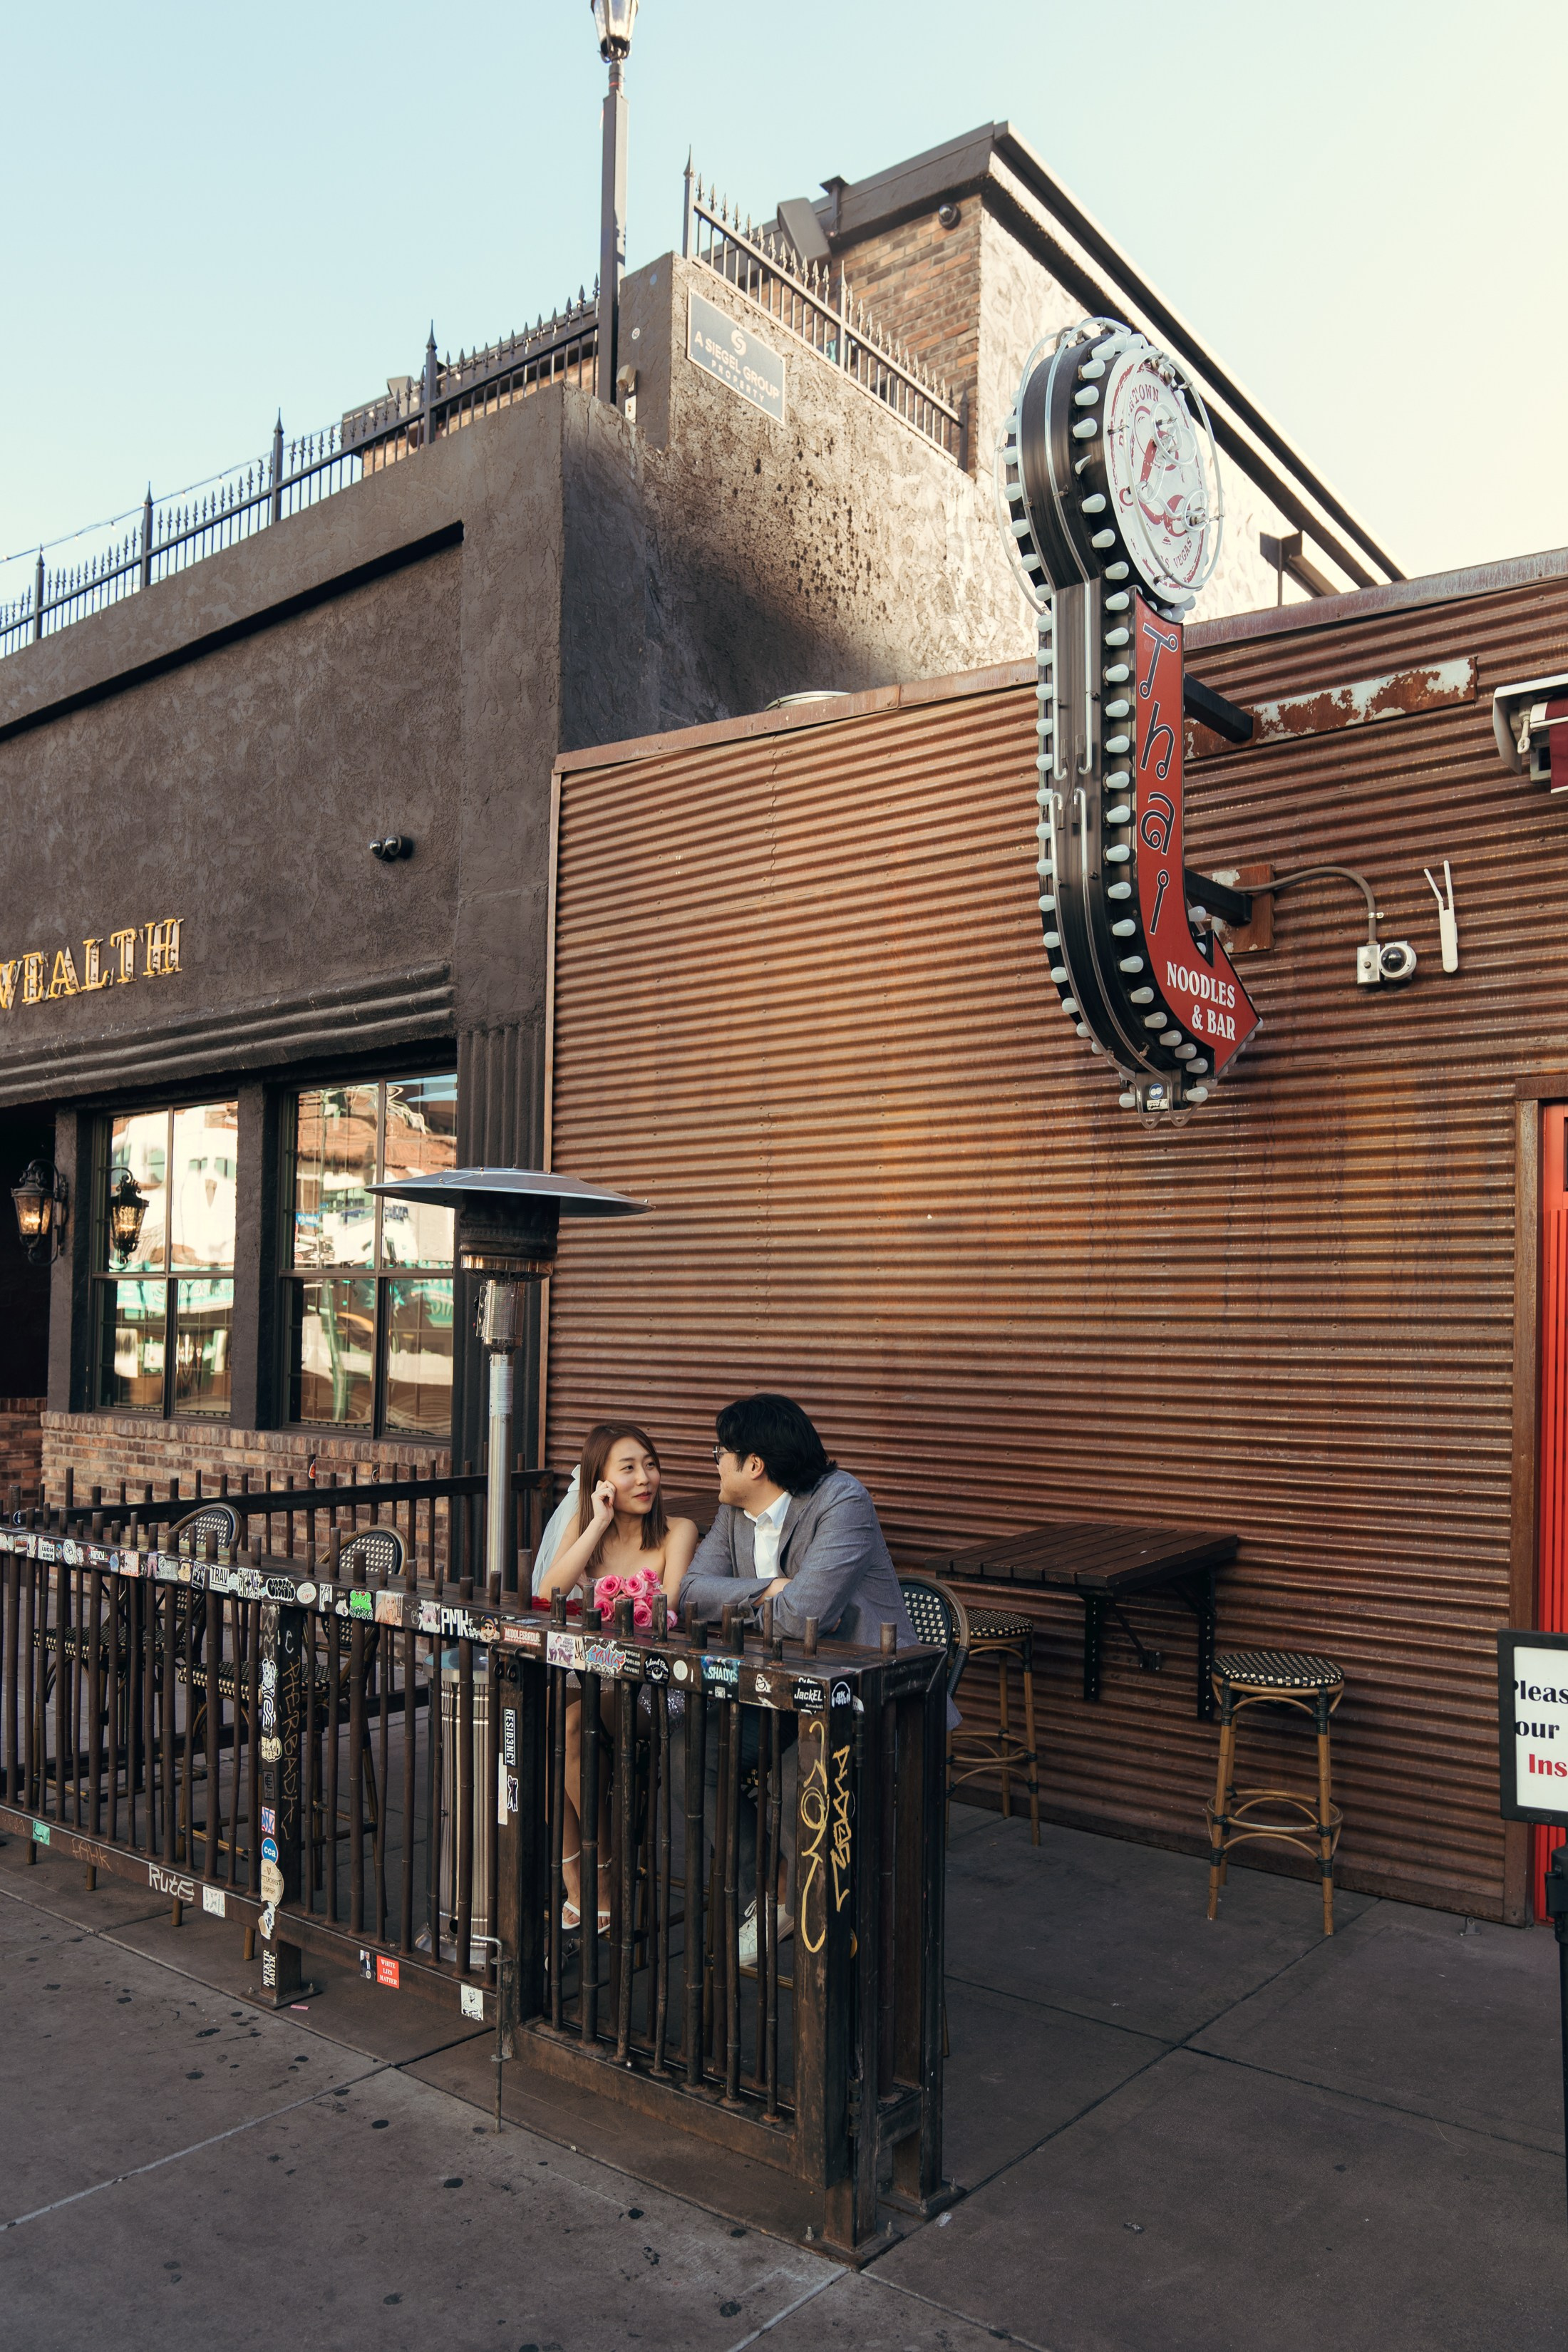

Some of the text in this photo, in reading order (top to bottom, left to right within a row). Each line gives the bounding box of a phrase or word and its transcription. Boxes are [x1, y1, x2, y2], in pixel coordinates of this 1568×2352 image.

[694, 331, 781, 400] A SIEGEL GROUP
[711, 359, 765, 403] PROPERTY
[1173, 537, 1192, 569] VEGAS
[1138, 622, 1179, 936] Thai
[1166, 960, 1236, 1009] NOODLES
[1191, 1004, 1237, 1042] & BAR
[505, 1708, 515, 1766] RESID3NCY
[379, 1975, 398, 1986] MATTER
[381, 1959, 396, 1969] WHITE
[383, 1967, 393, 1976] LIES
